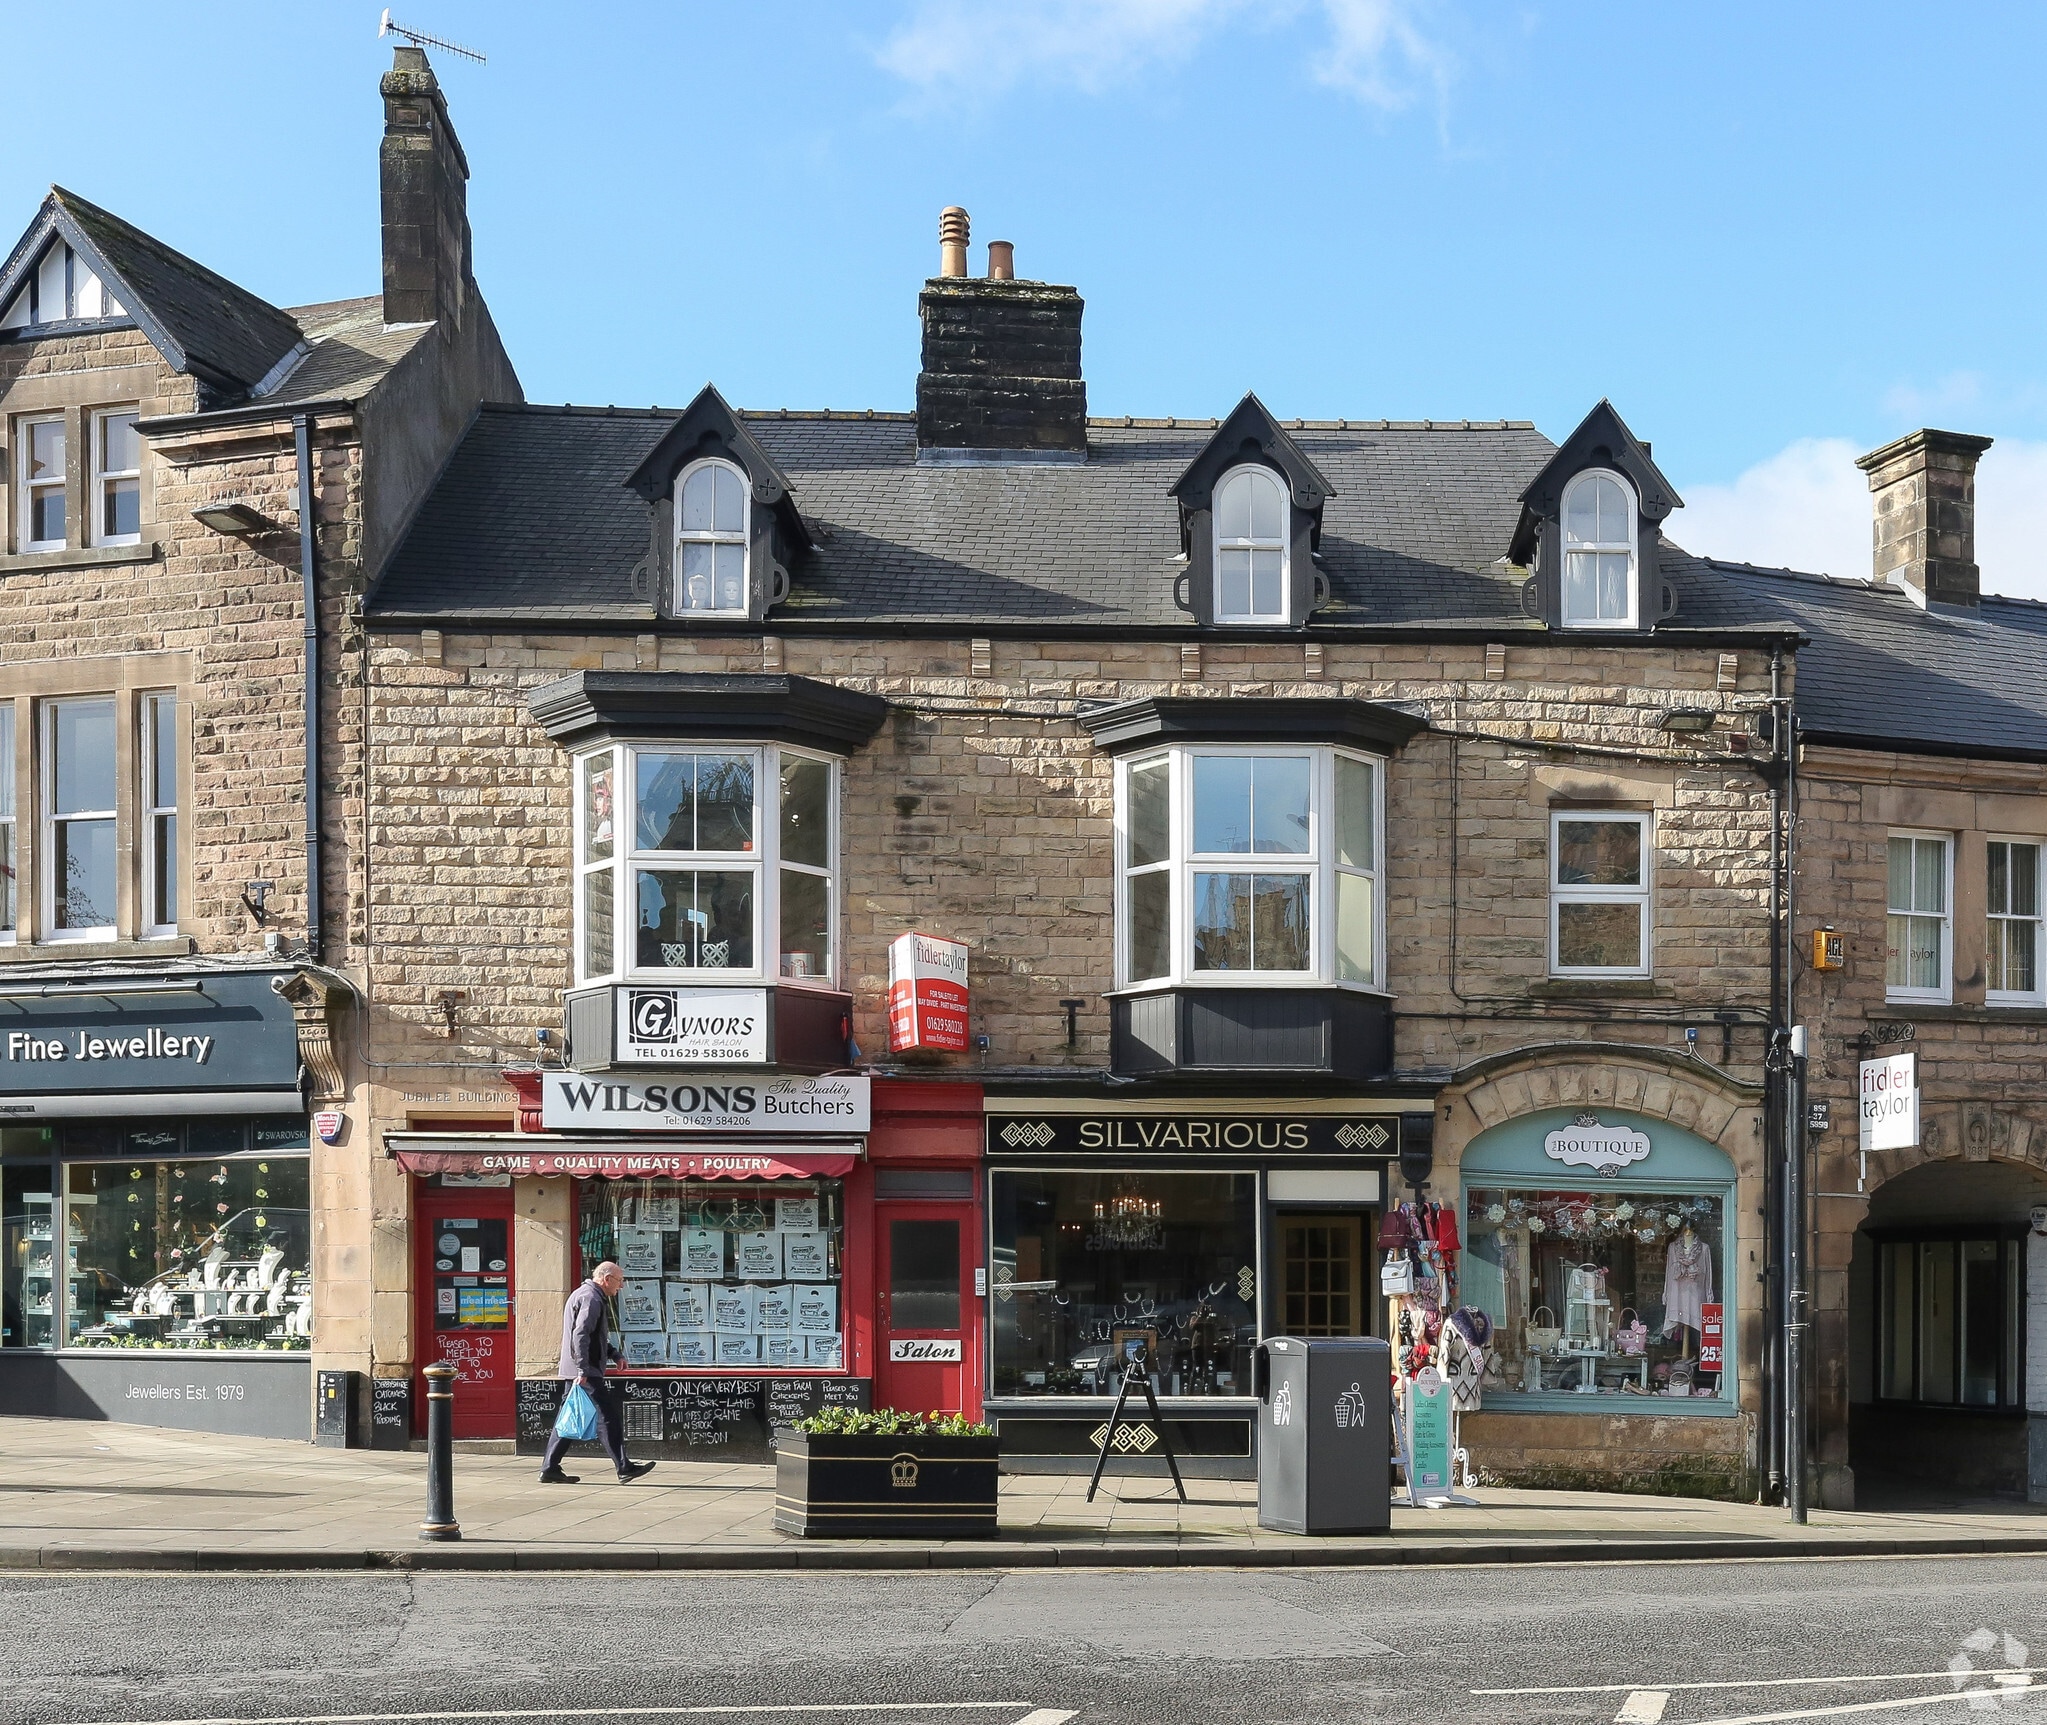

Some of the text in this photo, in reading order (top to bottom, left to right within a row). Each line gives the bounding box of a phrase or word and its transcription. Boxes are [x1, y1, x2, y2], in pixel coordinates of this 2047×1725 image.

[1910, 947, 1934, 962] aylor
[637, 998, 755, 1039] GAYNORS
[926, 1016, 945, 1031] 01629
[8, 1027, 211, 1064] Fine Jewellery
[689, 1038, 743, 1047] HAIR SALON
[635, 1049, 750, 1058] TEL 01629 583066
[1862, 1066, 1910, 1093] fidler
[399, 1091, 451, 1103] JUBILEE
[558, 1079, 851, 1114] WILSONS The Quality
[765, 1095, 855, 1115] Butchers
[1862, 1092, 1910, 1123] taylor
[664, 1116, 751, 1126] Tel: 01629 584206
[265, 1130, 307, 1140] SWAROVSKI
[1079, 1121, 1309, 1150] SILVARIOUS
[1557, 1140, 1644, 1156] BOUTIQUE
[482, 1156, 772, 1170] GAME QUALITY MEATS POULTRY
[1702, 1311, 1723, 1324] sale
[436, 1335, 493, 1348] PLEASED TO
[446, 1348, 492, 1359] MEET YOU
[894, 1341, 957, 1358] Salon
[468, 1359, 481, 1368] TO
[474, 1369, 494, 1379] YOU
[521, 1381, 557, 1393] ENGLISH
[668, 1380, 702, 1397] ONLY
[711, 1380, 737, 1393] VERY
[736, 1380, 762, 1394] BEST
[771, 1380, 812, 1391] FRESH FARM
[821, 1380, 859, 1392] PLEASED TO
[125, 1384, 245, 1400] Jewellers Est. 1979
[521, 1392, 551, 1402] BACON
[631, 1388, 662, 1399] BURGERS
[770, 1391, 810, 1401] CHICKENS
[824, 1393, 858, 1401] MEET YOU
[373, 1401, 398, 1413] BLACK
[727, 1397, 756, 1409] LAMB
[780, 1408, 804, 1417] FILLETS
[373, 1413, 401, 1427] PUDDING
[691, 1420, 714, 1430] STOCK
[685, 1431, 728, 1446] VENISON
